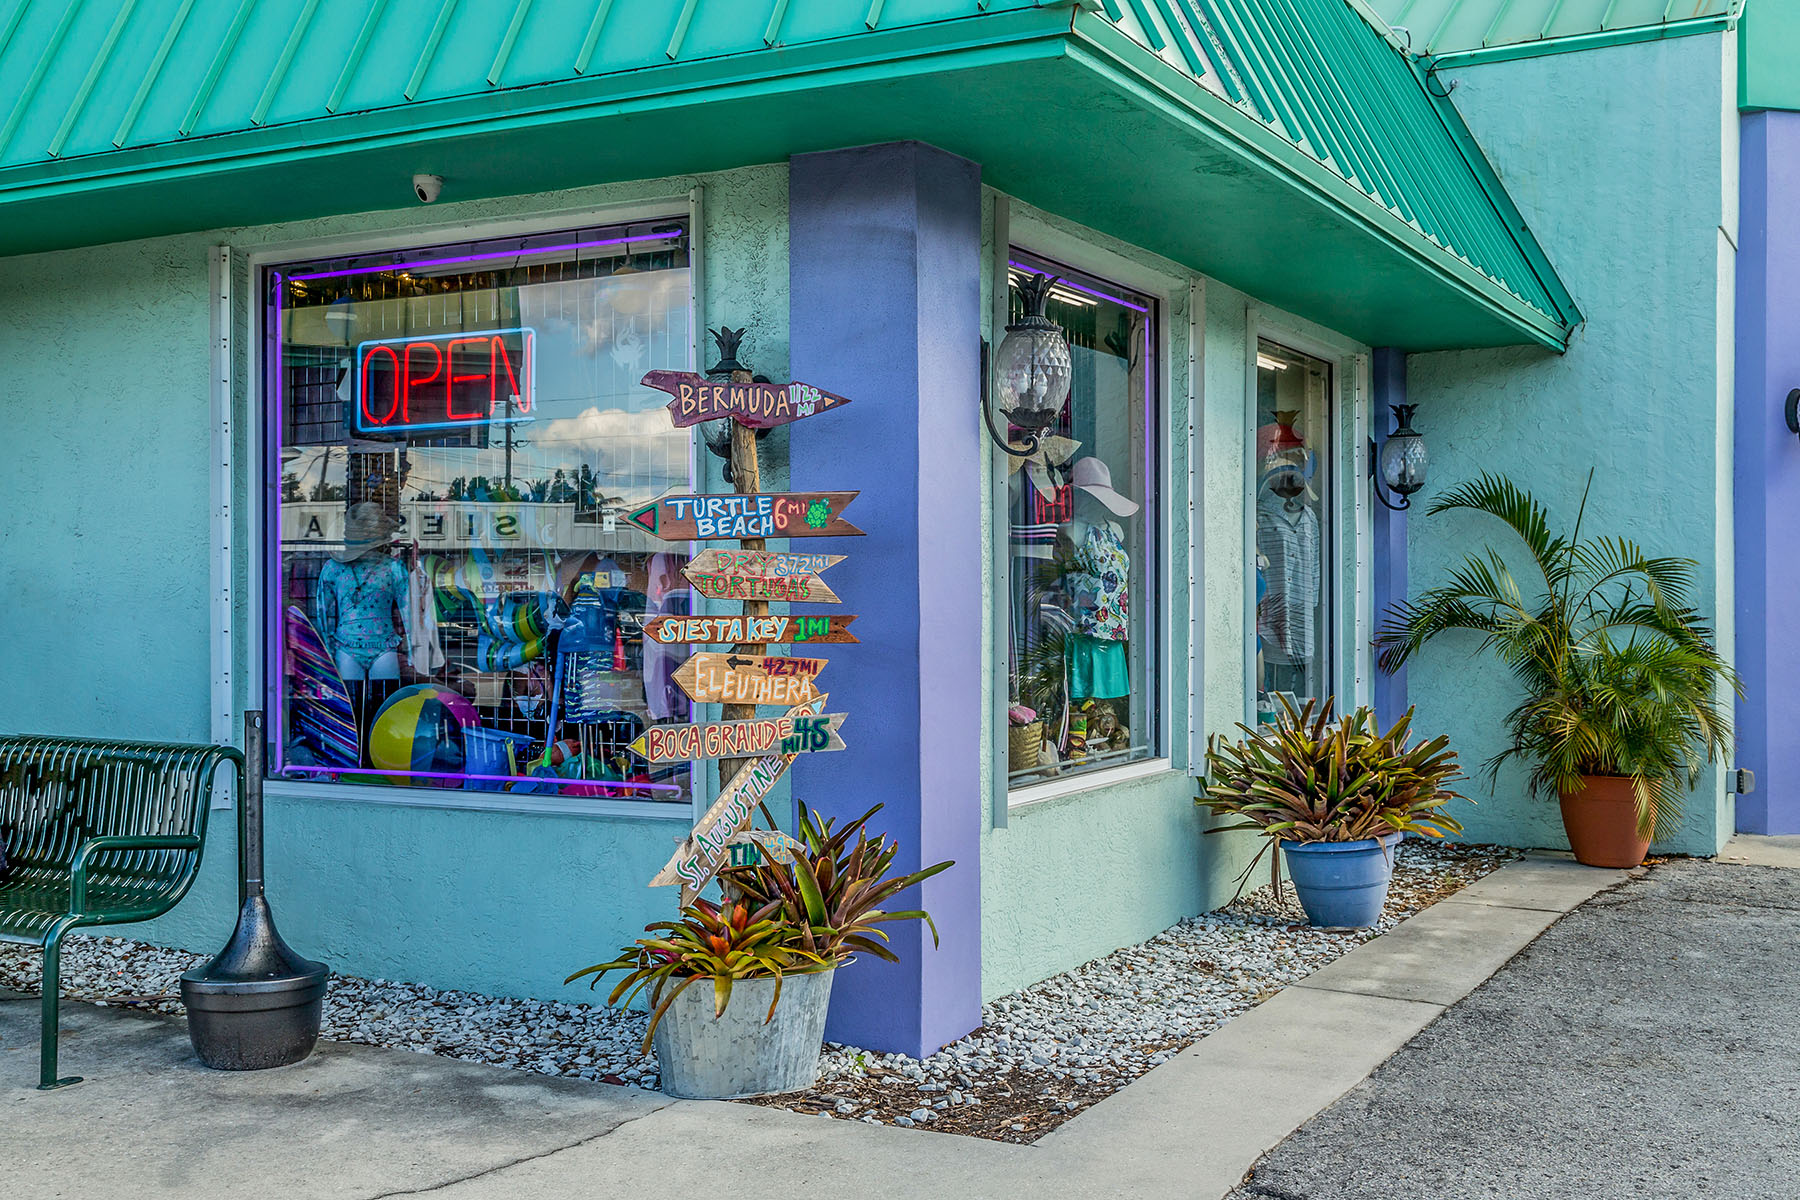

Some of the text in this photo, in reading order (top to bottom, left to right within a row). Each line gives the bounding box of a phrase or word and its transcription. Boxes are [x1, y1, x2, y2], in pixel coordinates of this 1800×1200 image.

[361, 332, 535, 425] OPEN
[678, 383, 822, 418] BERMUDA 1122
[796, 402, 815, 417] MI
[665, 497, 773, 520] TURTLE
[773, 498, 789, 530] 6
[696, 515, 774, 538] BEACH
[715, 551, 777, 576] DRY
[695, 572, 812, 601] TORTUGAS
[658, 617, 742, 642] SIESTA
[747, 615, 789, 641] KEY
[694, 656, 813, 703] ELEUTHERA
[648, 717, 831, 762] BOCA GRANDE 45
[781, 735, 801, 754] MI
[695, 754, 784, 867] AUGUSTINE
